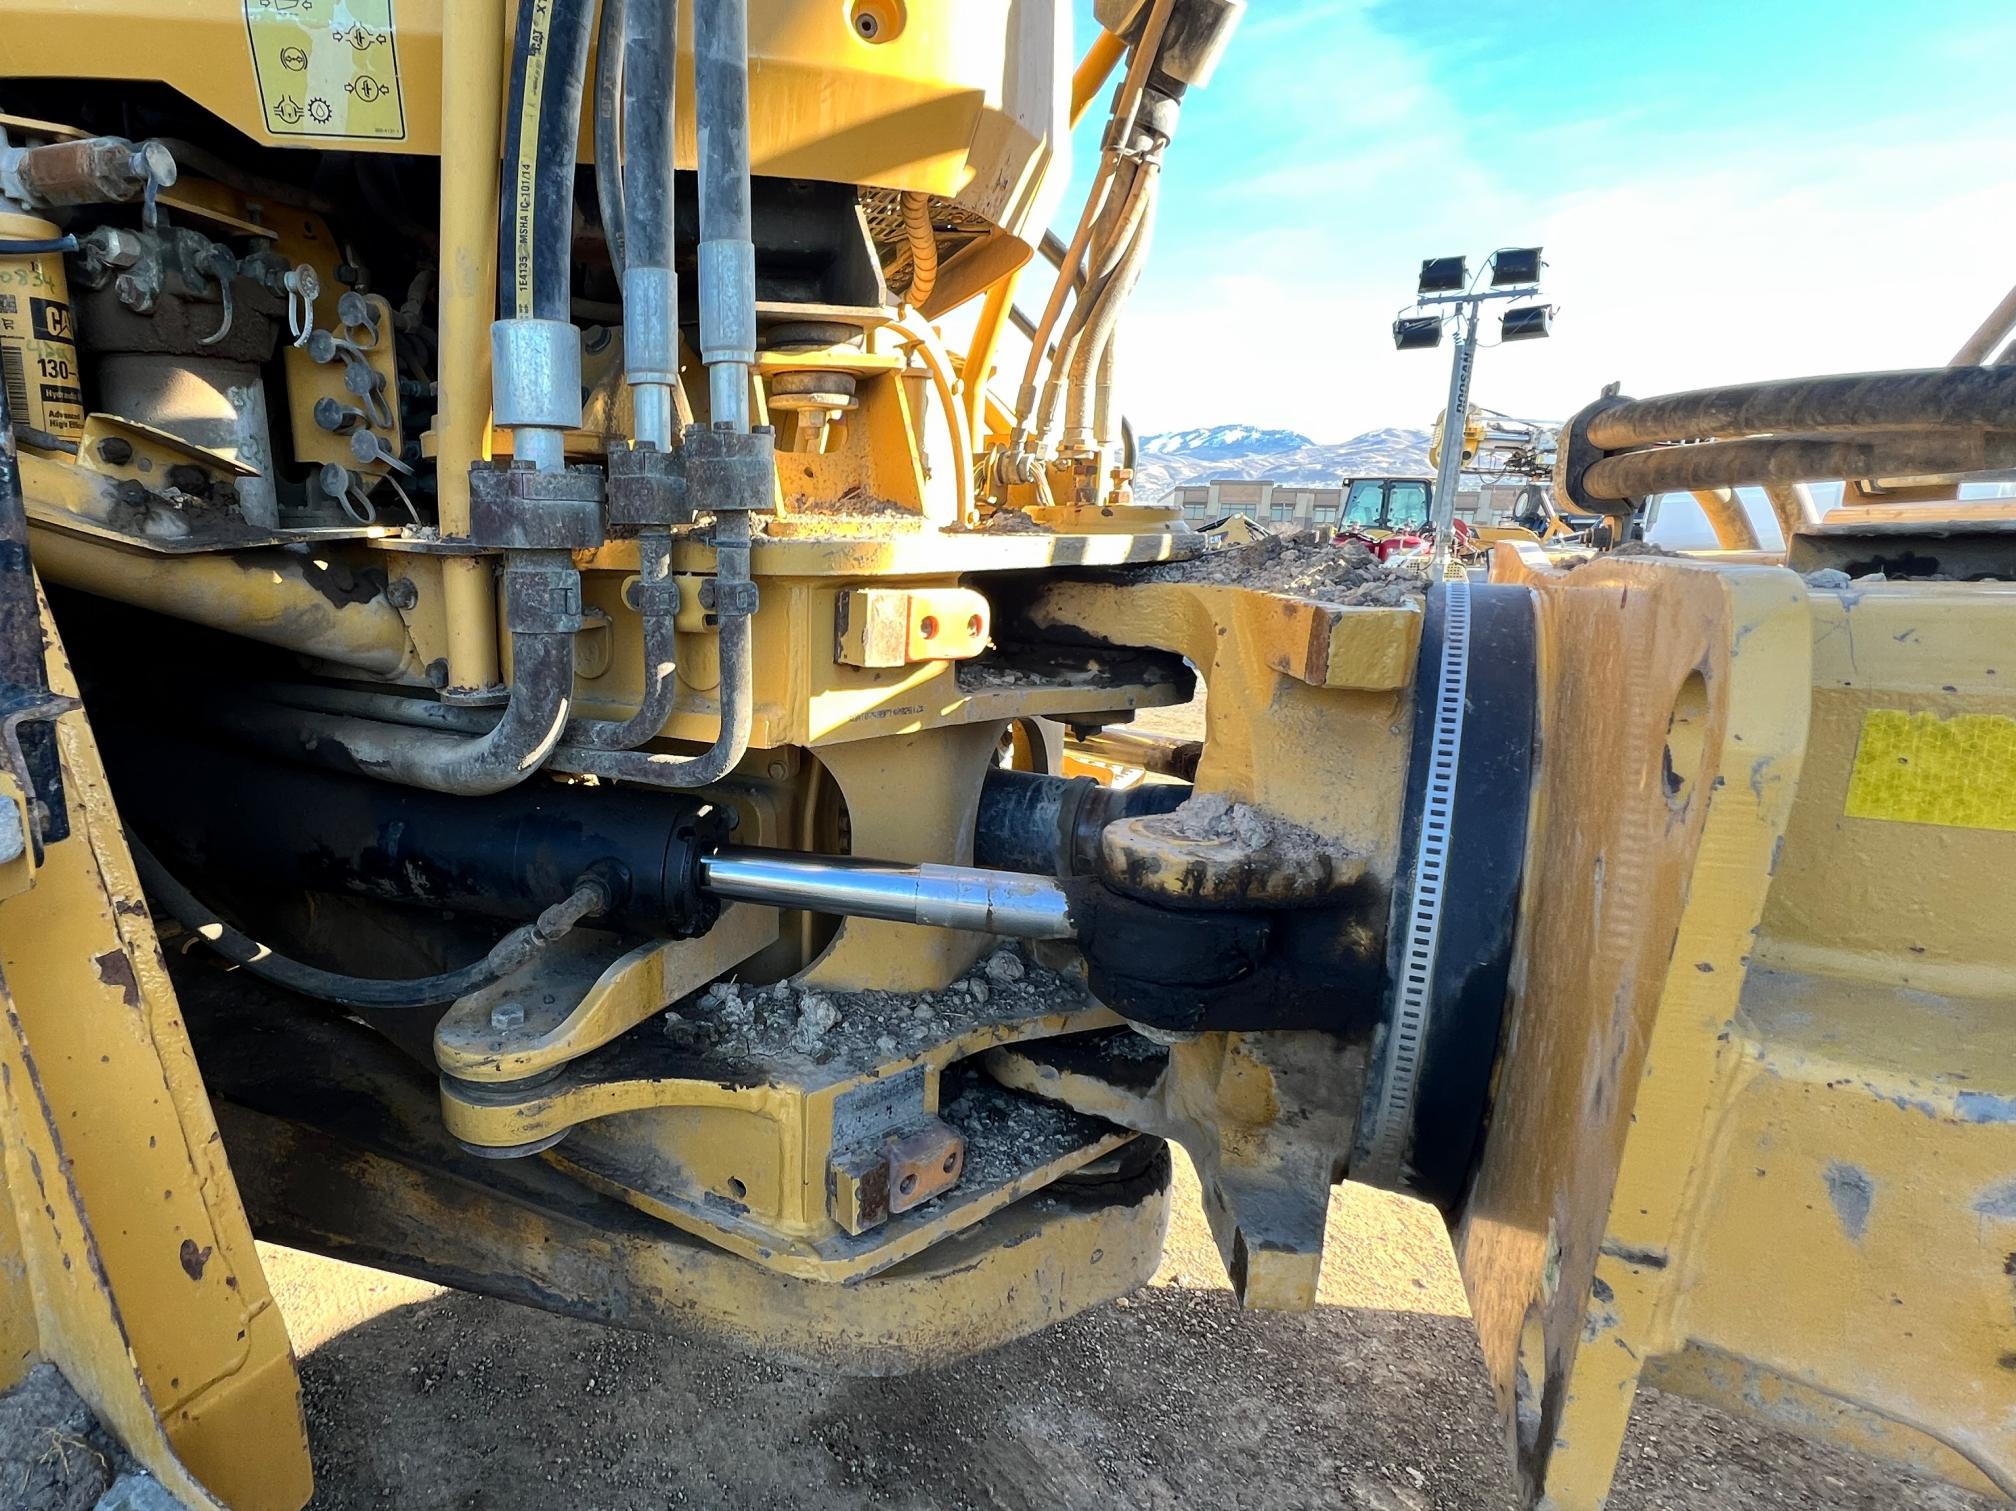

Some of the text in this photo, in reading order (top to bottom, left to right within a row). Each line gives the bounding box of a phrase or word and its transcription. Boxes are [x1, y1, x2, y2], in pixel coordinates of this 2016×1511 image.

[520, 164, 530, 212] IC-101/14
[519, 215, 529, 244] MSHA
[46, 306, 74, 340] CA
